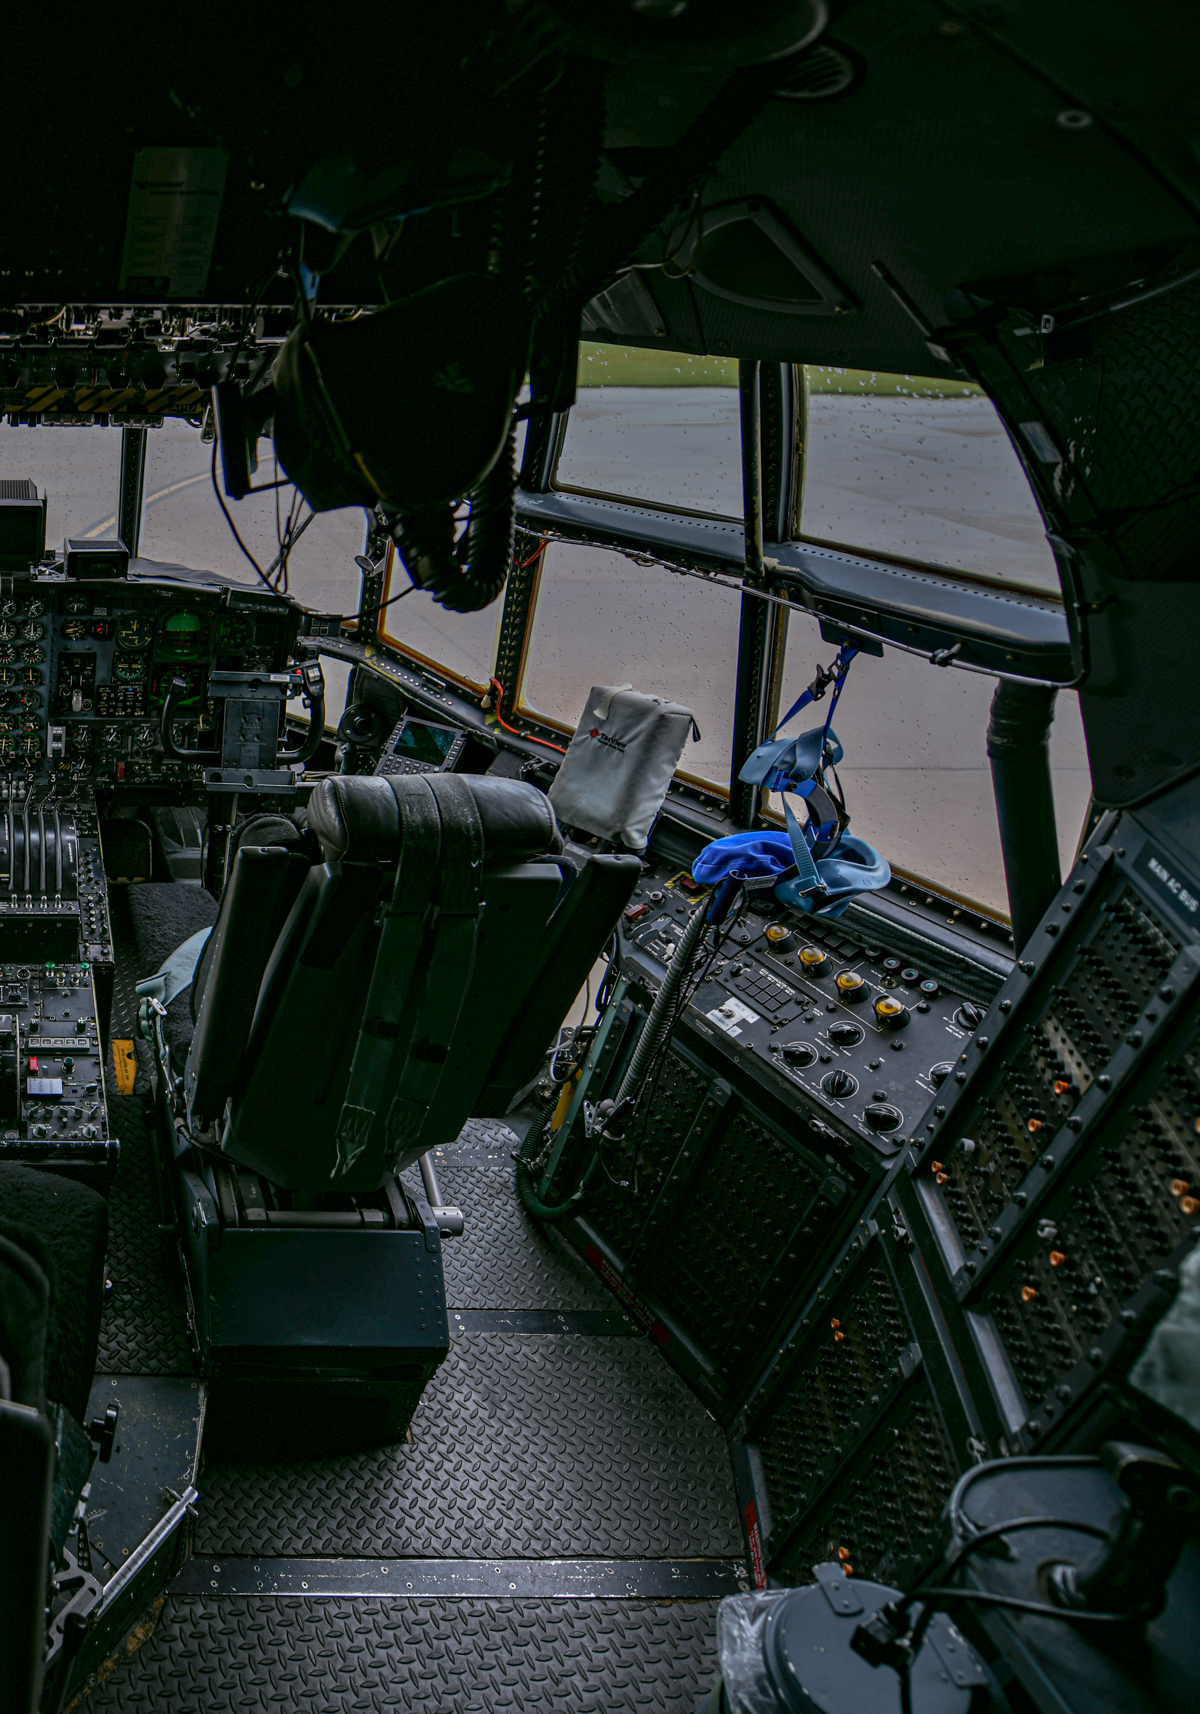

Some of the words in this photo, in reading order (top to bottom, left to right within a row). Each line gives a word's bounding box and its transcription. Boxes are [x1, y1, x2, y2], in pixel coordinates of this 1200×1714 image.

[600, 733, 627, 748] TacView
[1147, 857, 1170, 882] MAIN
[1166, 877, 1181, 894] AC
[1177, 888, 1199, 913] BUS
[634, 1297, 656, 1323] VOLTAGE
